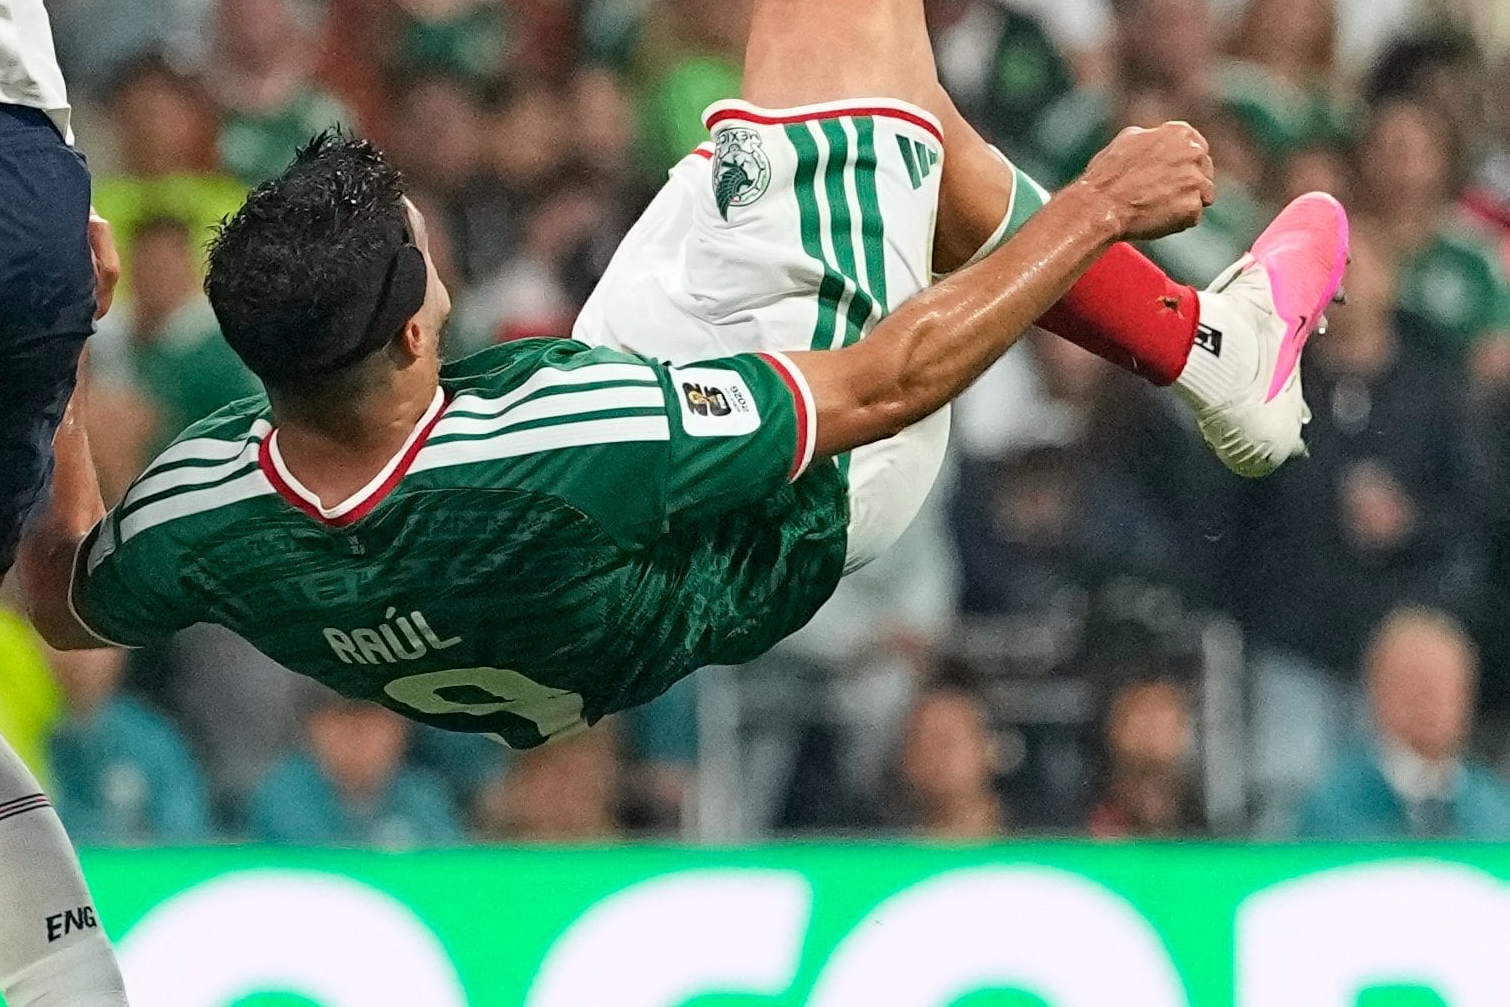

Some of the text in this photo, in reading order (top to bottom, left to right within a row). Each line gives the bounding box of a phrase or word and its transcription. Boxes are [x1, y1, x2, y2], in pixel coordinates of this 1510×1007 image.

[730, 385, 749, 412] 2026
[322, 606, 463, 665] RAÚL
[45, 905, 98, 943] ENG
